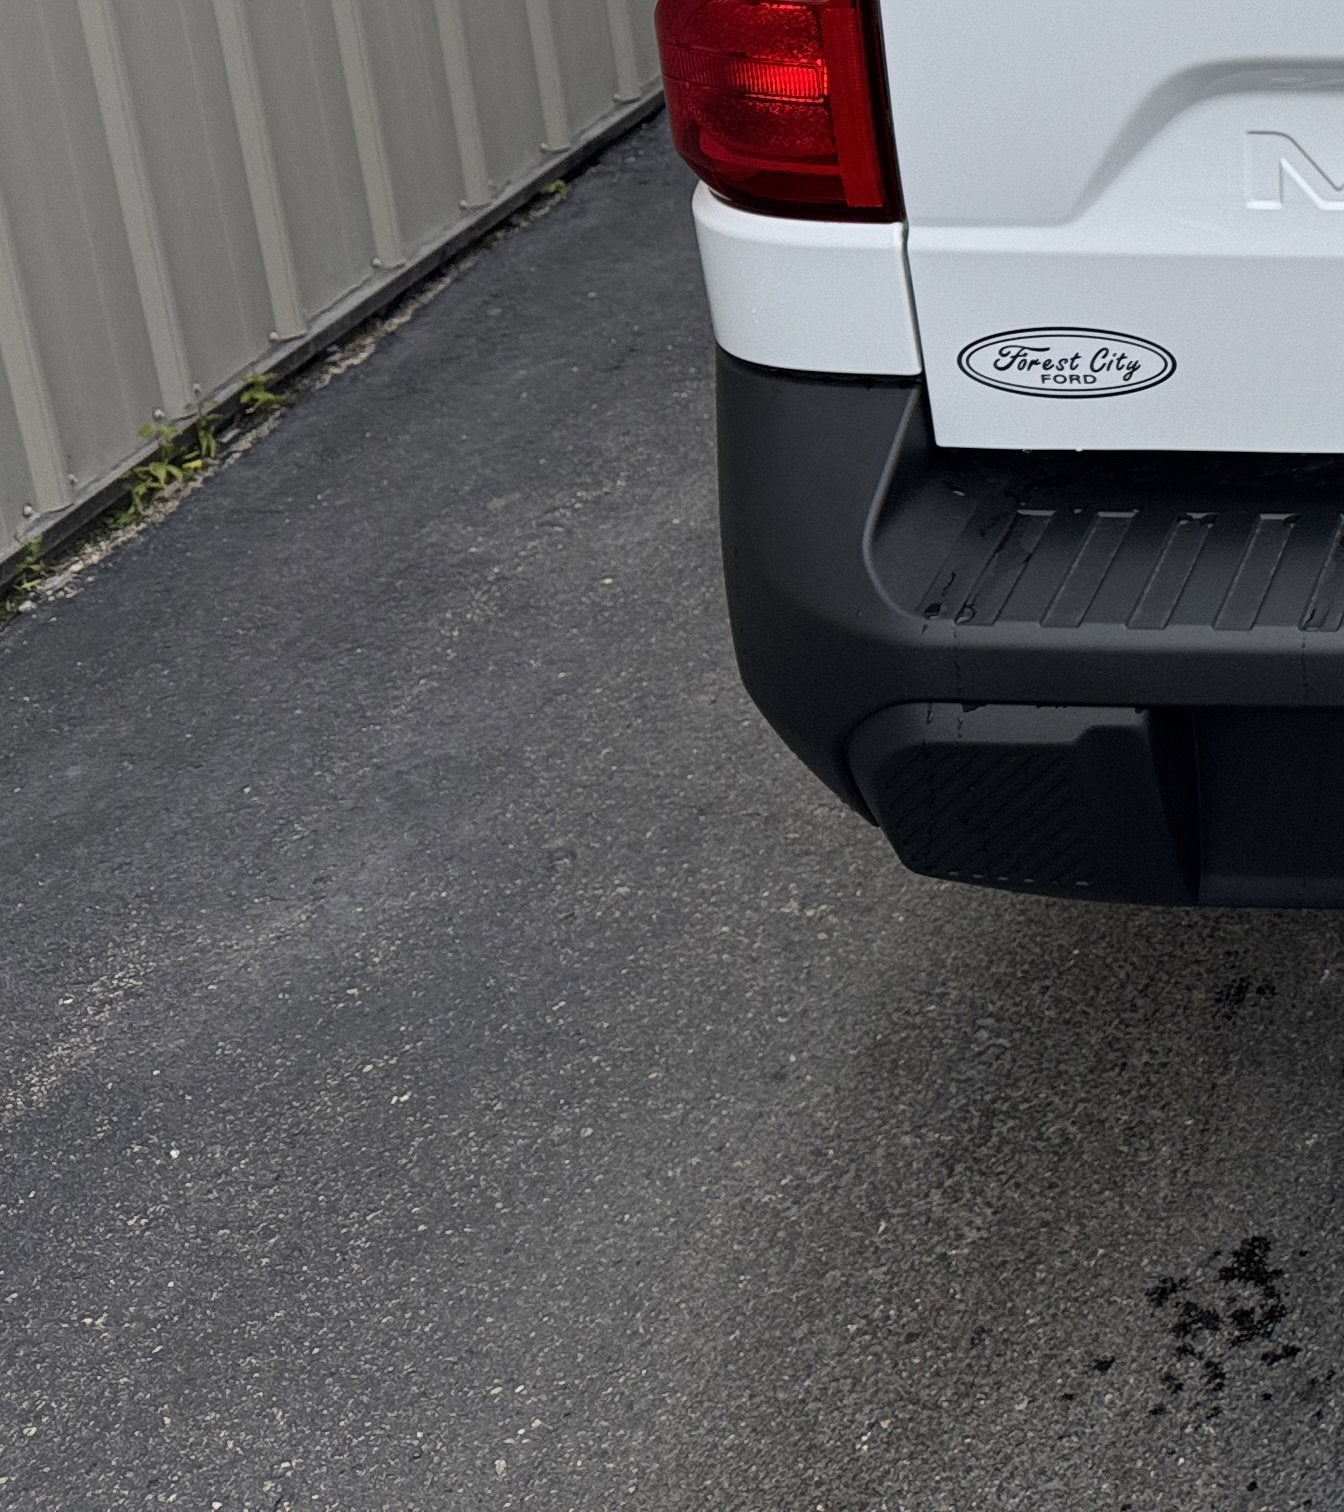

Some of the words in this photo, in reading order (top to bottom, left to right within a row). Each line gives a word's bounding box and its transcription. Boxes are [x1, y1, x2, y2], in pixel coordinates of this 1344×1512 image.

[993, 345, 1082, 371] Forest
[1089, 347, 1141, 381] City
[1040, 374, 1097, 384] FORD
